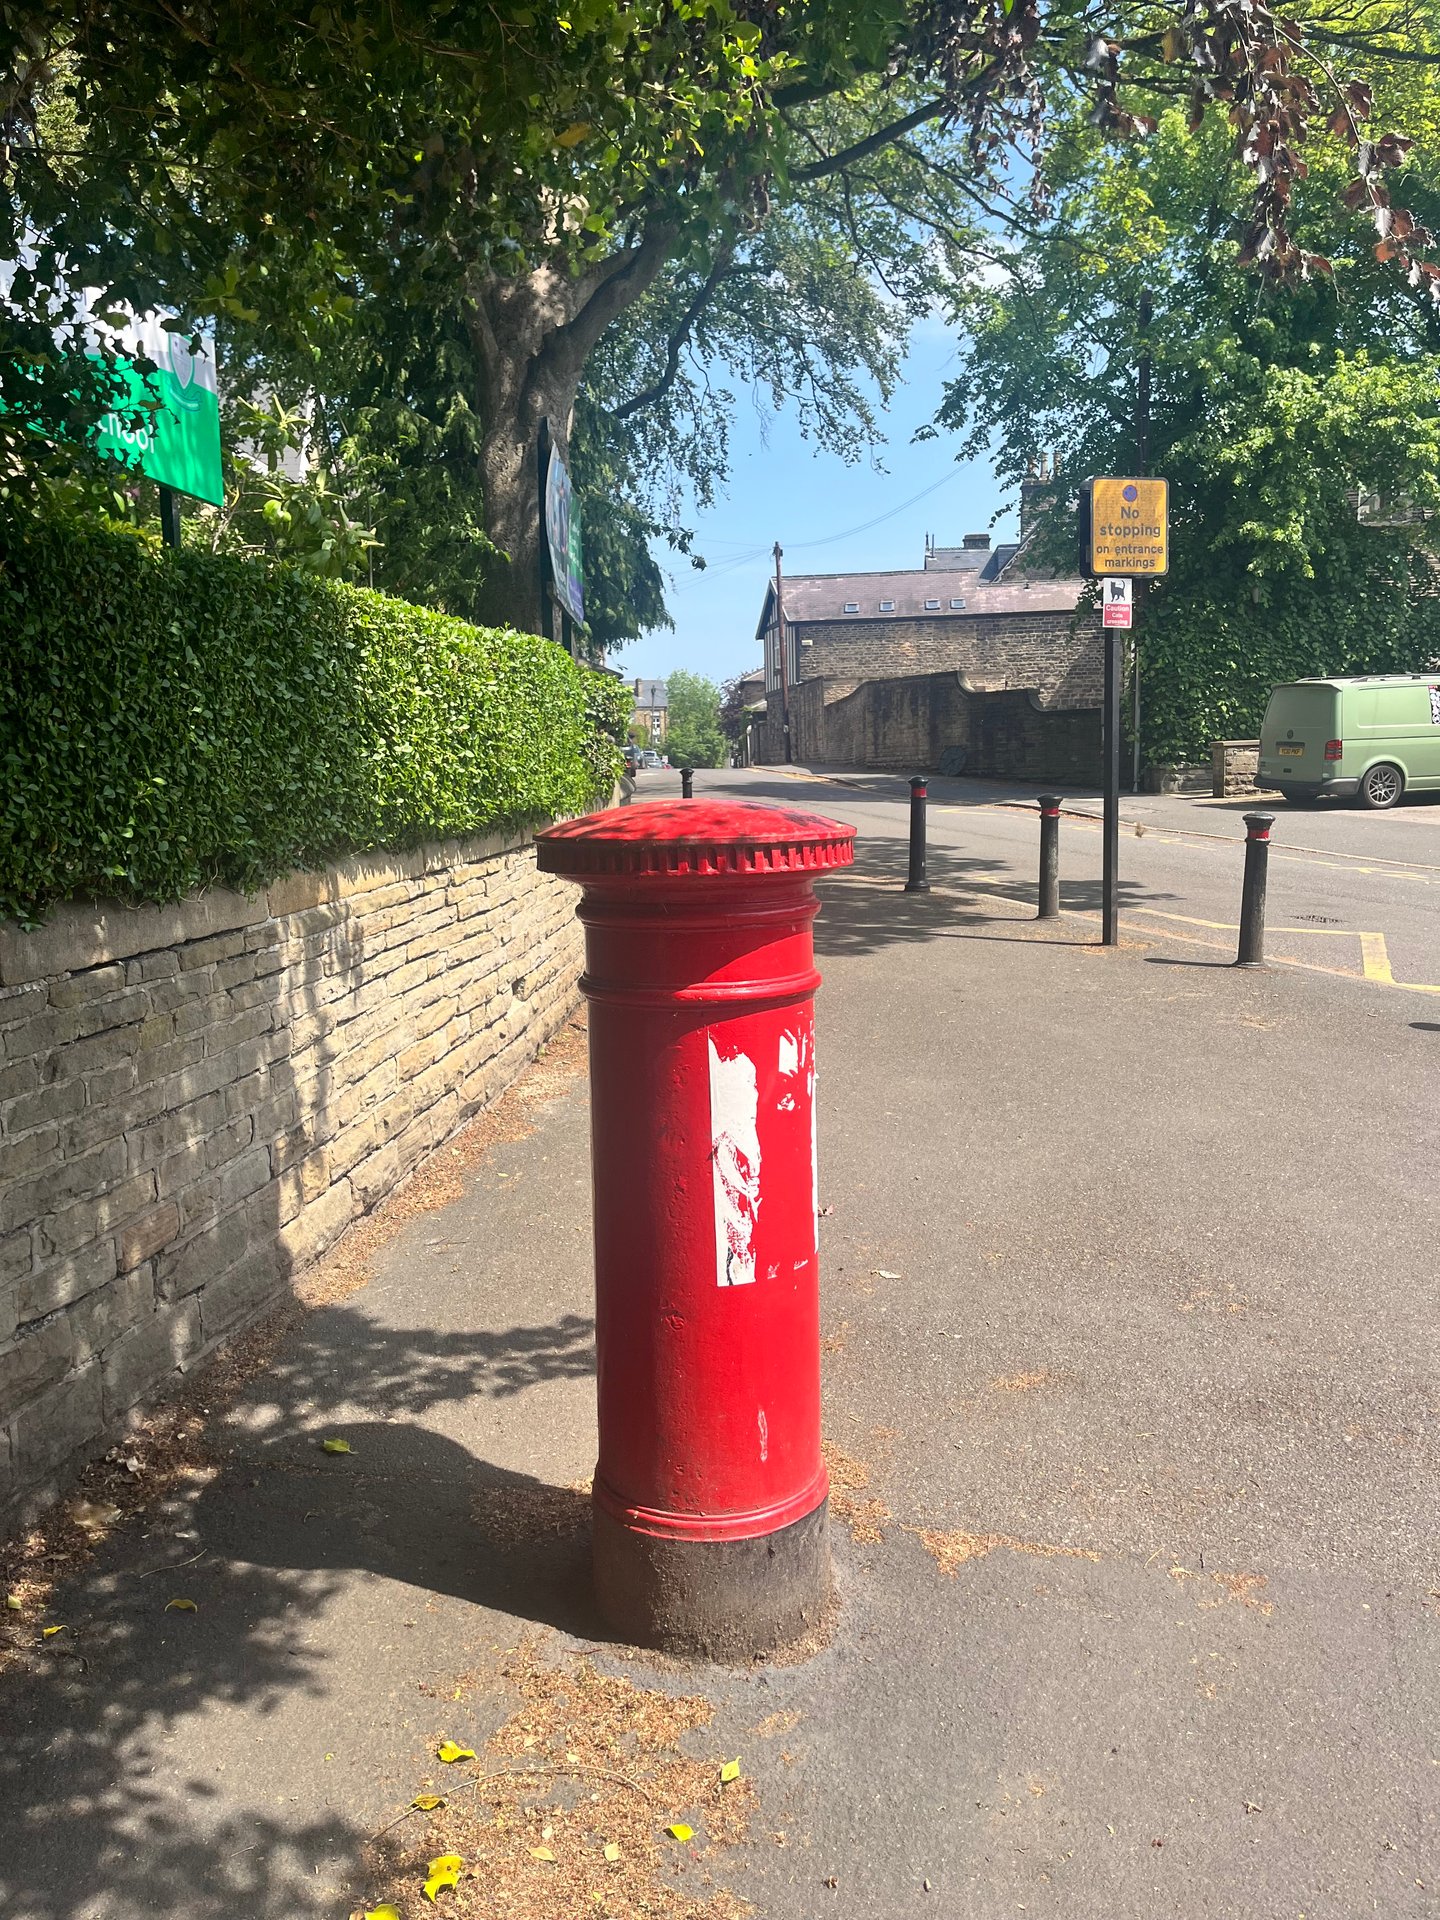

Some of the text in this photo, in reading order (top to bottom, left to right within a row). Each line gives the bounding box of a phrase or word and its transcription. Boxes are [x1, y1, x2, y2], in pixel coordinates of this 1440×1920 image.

[1121, 506, 1140, 519] No
[1099, 523, 1161, 538] stopping
[1096, 543, 1164, 555] on entrance
[1104, 557, 1155, 569] markings
[1105, 604, 1130, 612] Caution
